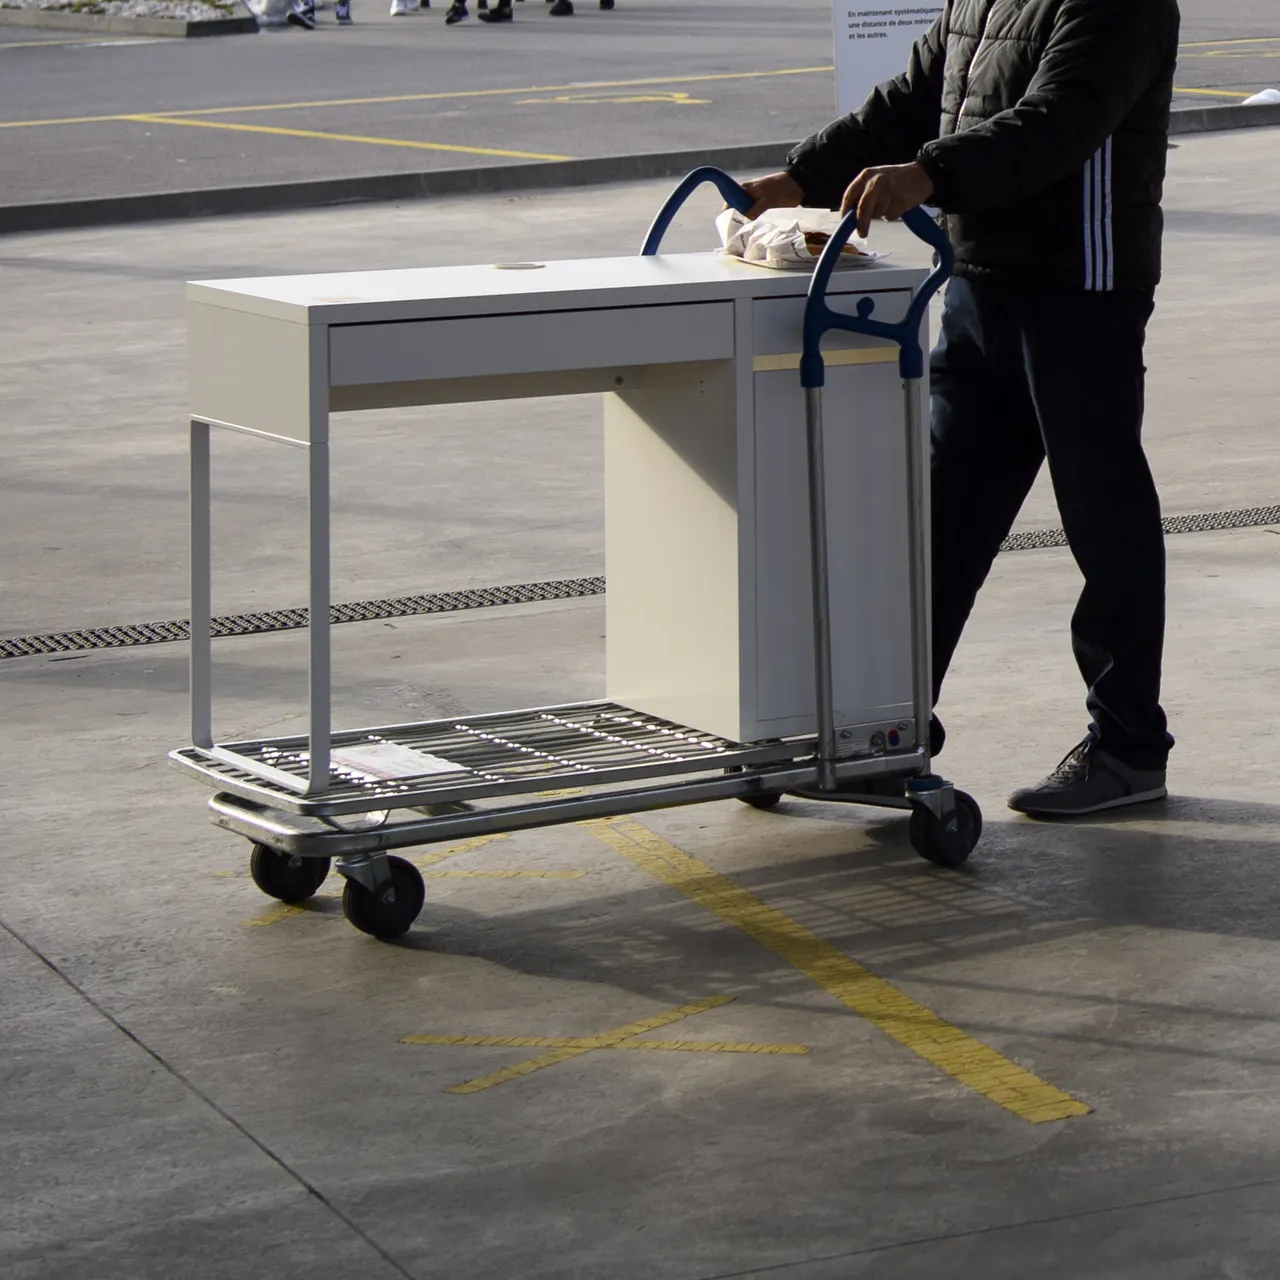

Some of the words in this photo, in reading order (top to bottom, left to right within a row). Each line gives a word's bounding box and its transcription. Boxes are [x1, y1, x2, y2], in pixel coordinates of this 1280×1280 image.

[848, 10, 856, 18] En
[857, 8, 893, 17] maintenant
[894, 7, 944, 17] systématiqueme
[861, 20, 888, 28] distance
[888, 19, 897, 27] de
[897, 18, 913, 26] deux
